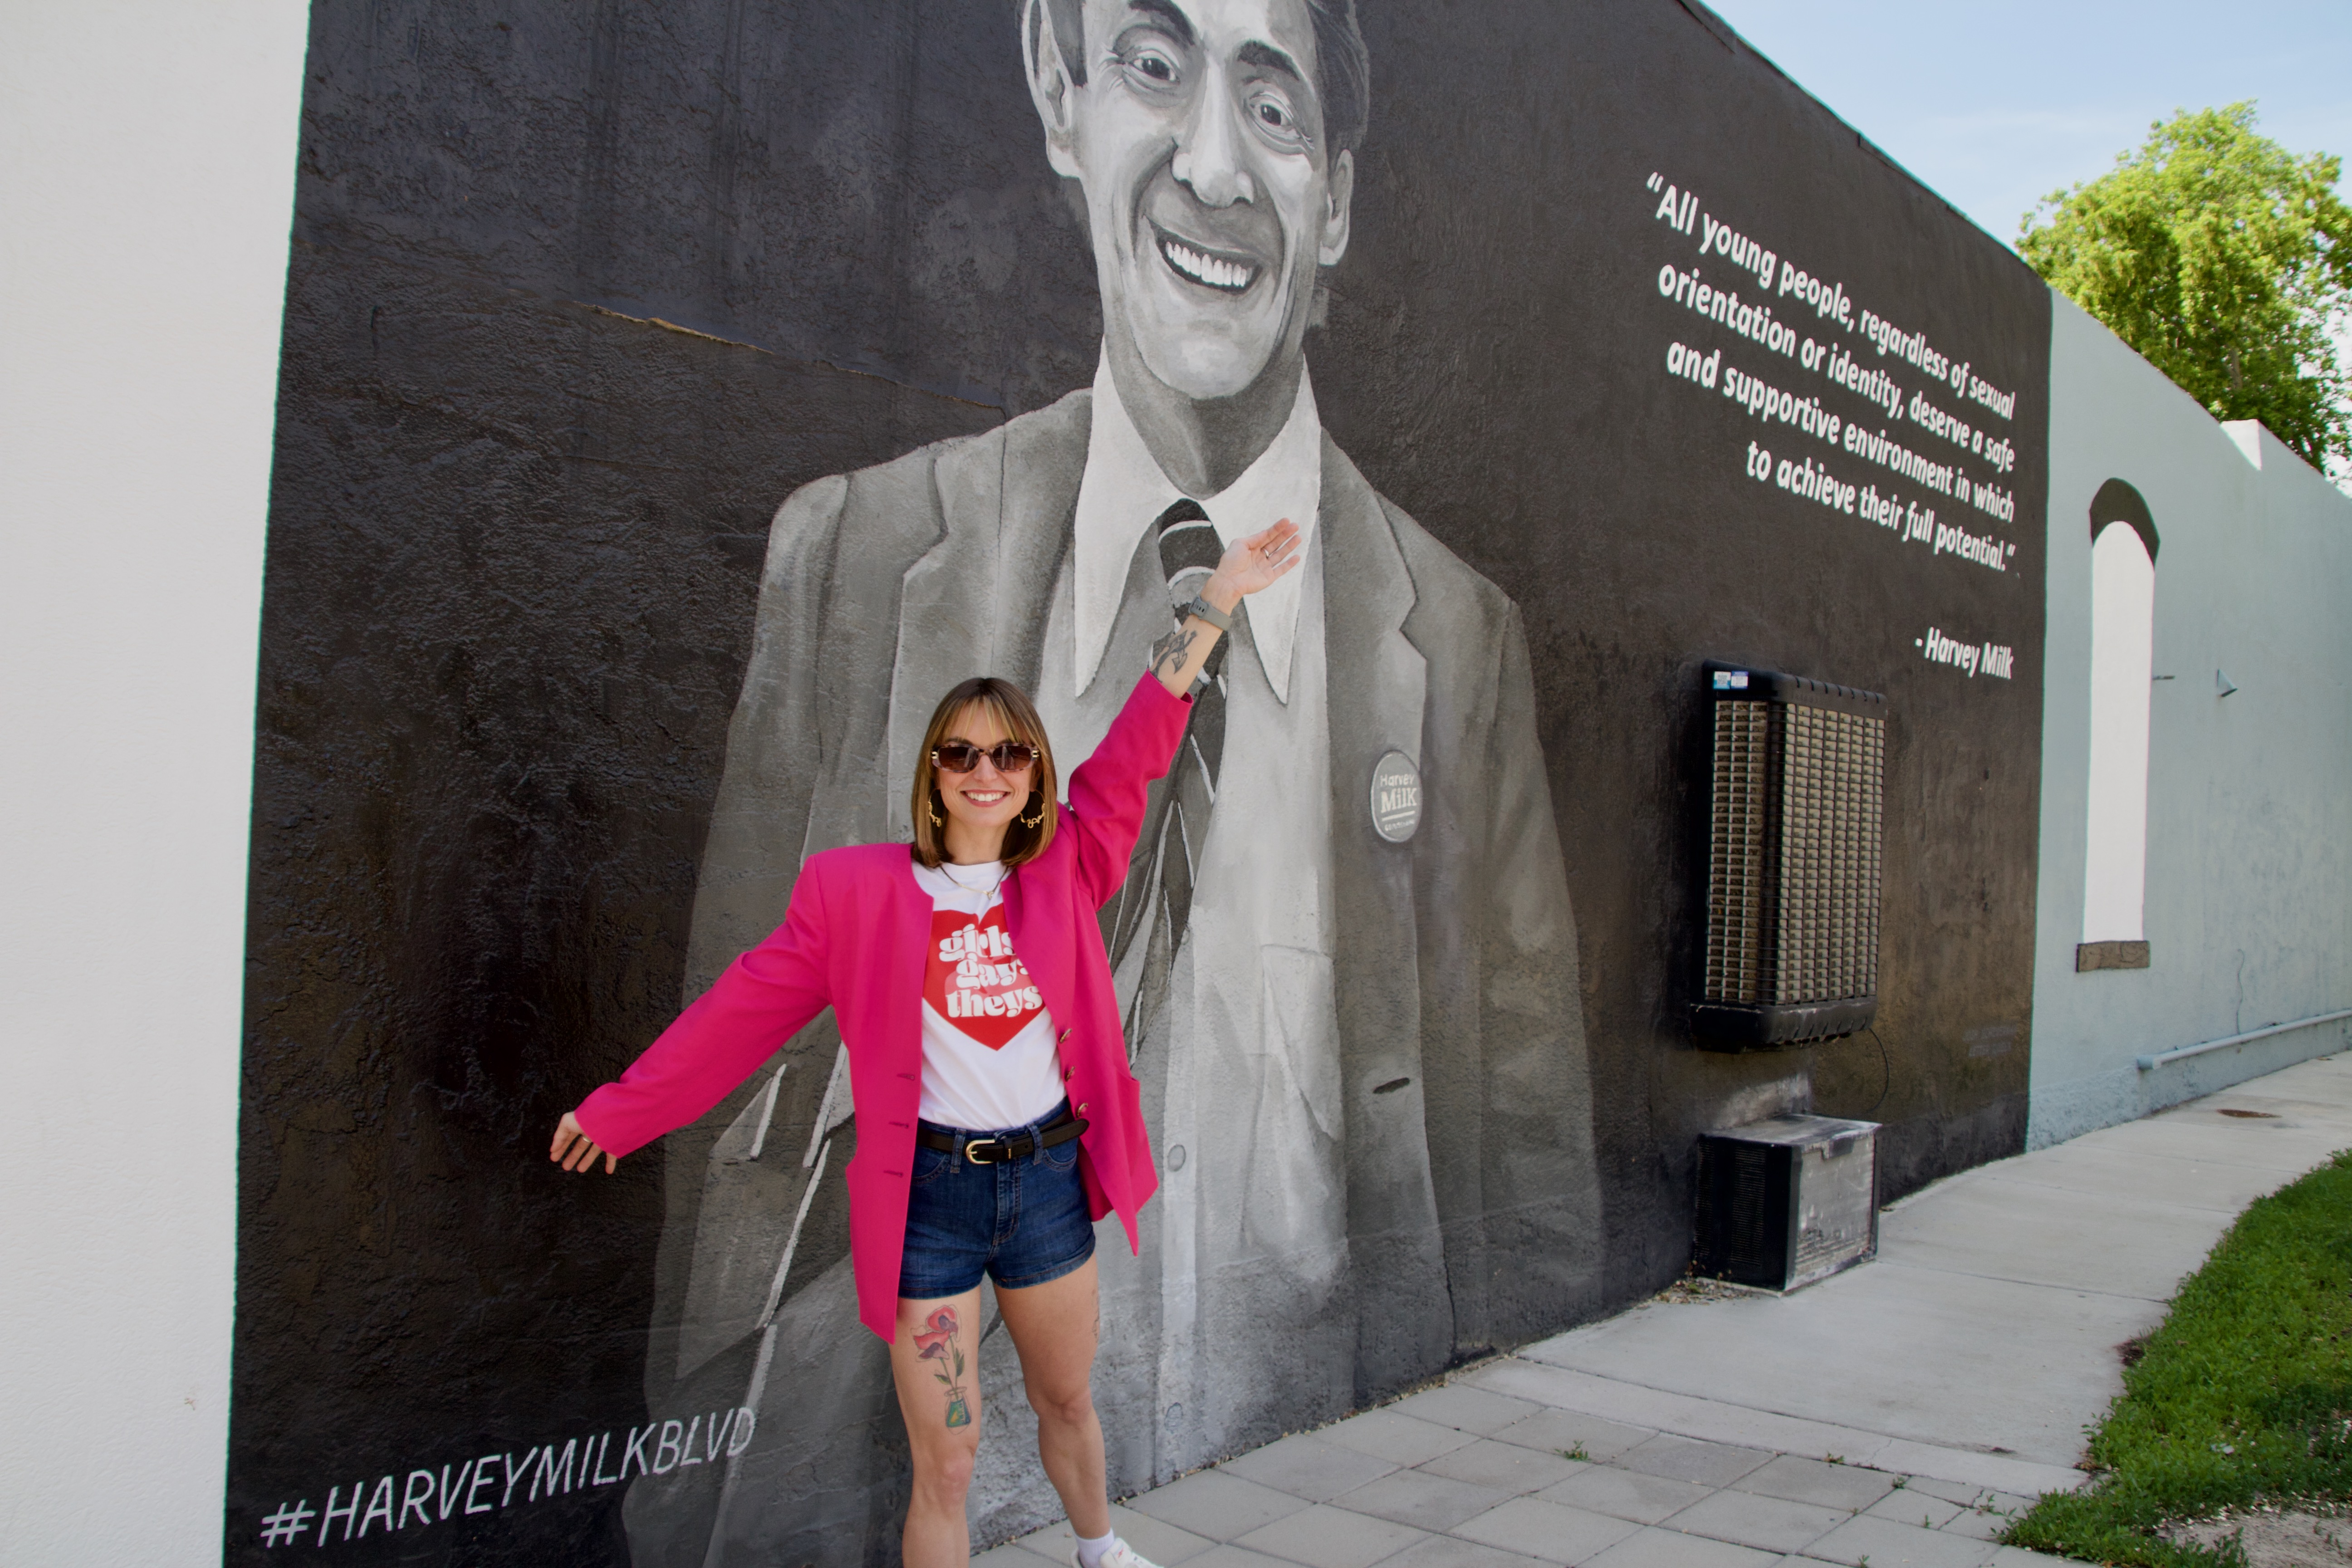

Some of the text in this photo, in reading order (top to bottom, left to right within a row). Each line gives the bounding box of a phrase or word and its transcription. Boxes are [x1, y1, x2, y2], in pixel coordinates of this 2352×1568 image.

[1658, 264, 2015, 473] orientation or identity, deserve a safe
[1699, 213, 1777, 289] young
[1778, 260, 1855, 333] people,
[1859, 309, 1949, 381] regardless
[1950, 362, 1970, 398] of
[1969, 376, 2015, 420] sexual
[1667, 342, 2014, 523] and supportive environment in which
[1747, 441, 1772, 481] to
[1776, 456, 1856, 514] achieve
[1859, 485, 1904, 530] their
[1902, 500, 1935, 543] full
[1925, 627, 1980, 678] Harvey
[1980, 642, 2014, 680] Milk
[939, 924, 1015, 961] girls
[946, 986, 1043, 1017] theys
[260, 1407, 756, 1548] #HARVEYMILKBLVD
